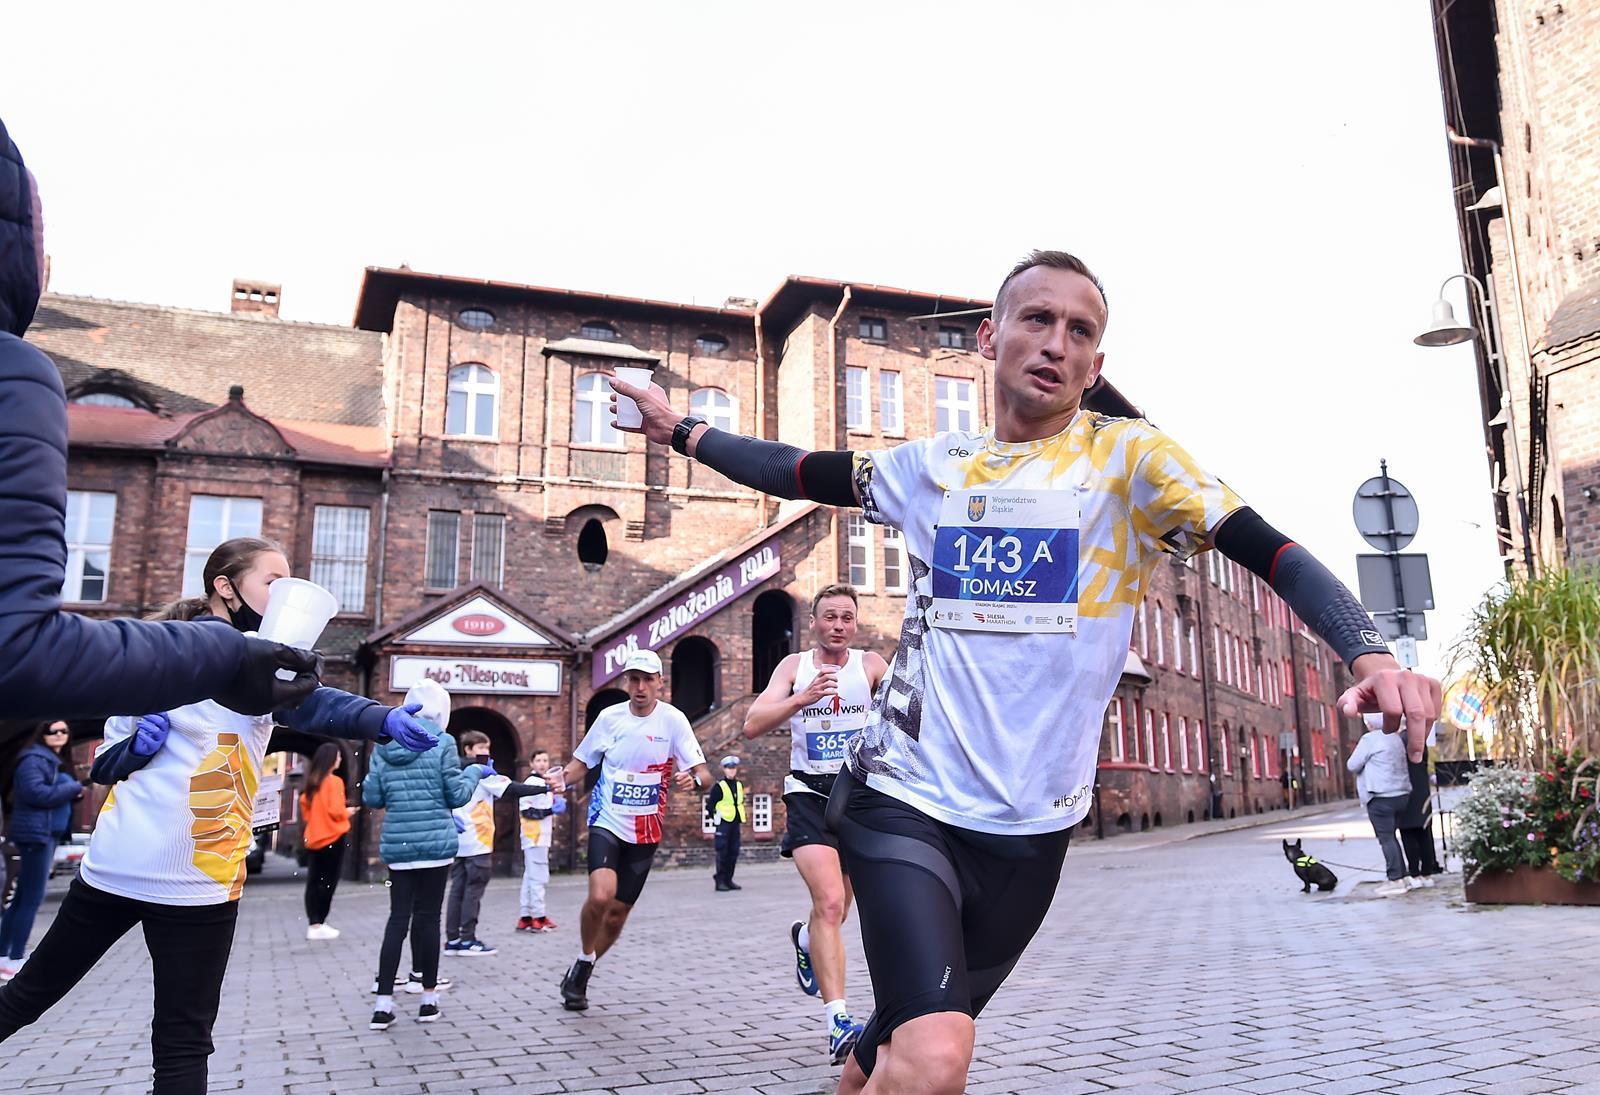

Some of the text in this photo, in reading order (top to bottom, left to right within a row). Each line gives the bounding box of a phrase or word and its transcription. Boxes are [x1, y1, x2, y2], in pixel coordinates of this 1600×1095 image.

[948, 446, 973, 457] de
[992, 496, 1037, 504] Województwo
[991, 505, 1014, 514] Śląskie
[953, 534, 1053, 574] 143 A
[960, 577, 1037, 597] TOMASZ
[604, 546, 774, 675] rok założenia 1919
[816, 733, 847, 751] 365
[615, 784, 658, 799] 2582 A
